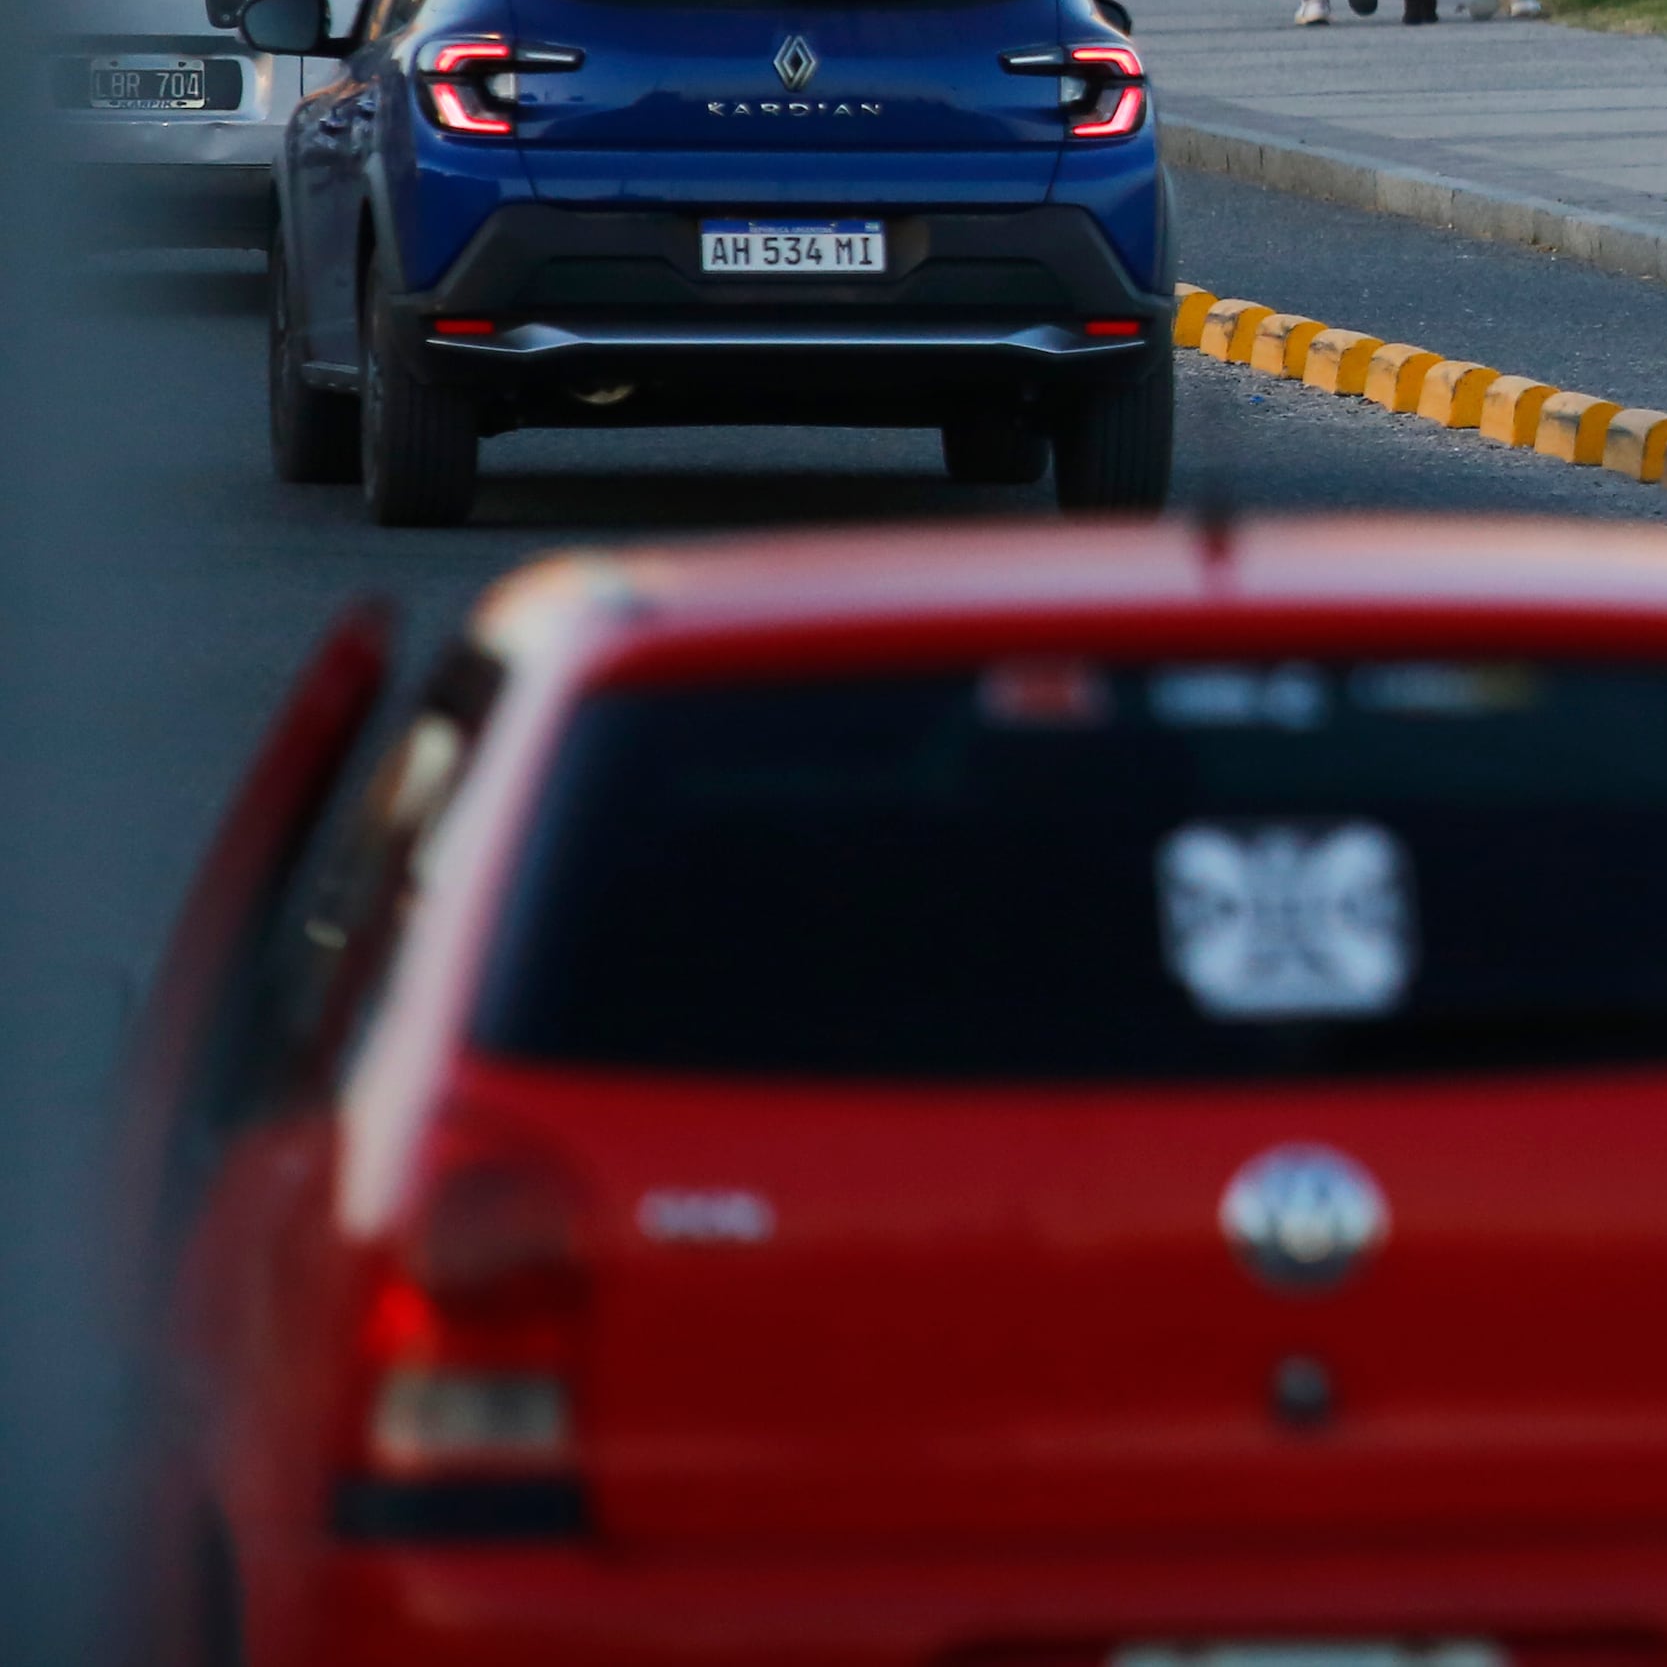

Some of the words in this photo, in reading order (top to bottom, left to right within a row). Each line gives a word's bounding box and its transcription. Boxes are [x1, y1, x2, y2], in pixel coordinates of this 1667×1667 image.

[156, 72, 199, 98] 704
[707, 101, 881, 117] KARDIAN
[711, 237, 750, 265] AH
[762, 237, 823, 265] 534
[835, 237, 873, 265] MI
